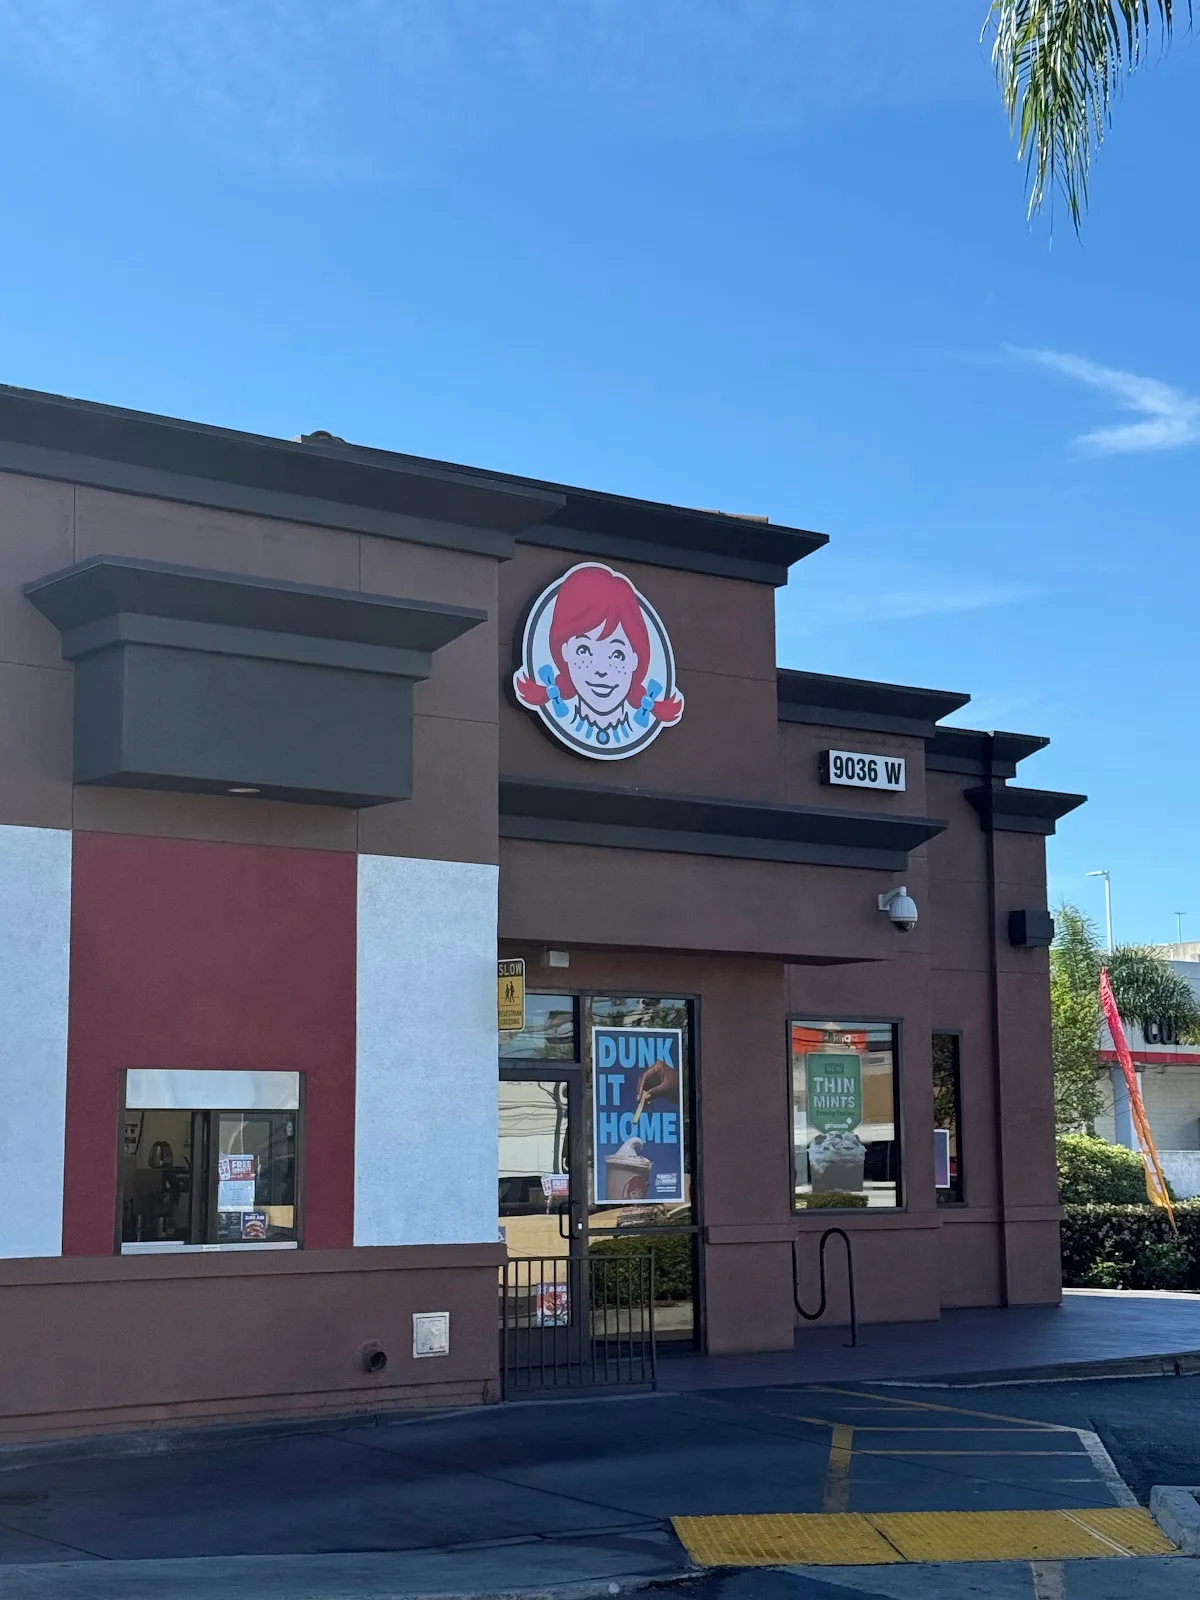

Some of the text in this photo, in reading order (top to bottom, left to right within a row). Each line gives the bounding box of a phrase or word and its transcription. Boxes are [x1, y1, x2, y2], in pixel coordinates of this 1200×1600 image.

[833, 755, 902, 785] 9036 W
[498, 963, 522, 976] SLOW
[598, 1036, 675, 1069] DUNK
[826, 1064, 842, 1073] NEW
[600, 1074, 625, 1106] IT
[813, 1076, 856, 1094] THIN
[813, 1095, 856, 1108] MINTS
[600, 1111, 678, 1144] HOME
[231, 1160, 252, 1168] FREE
